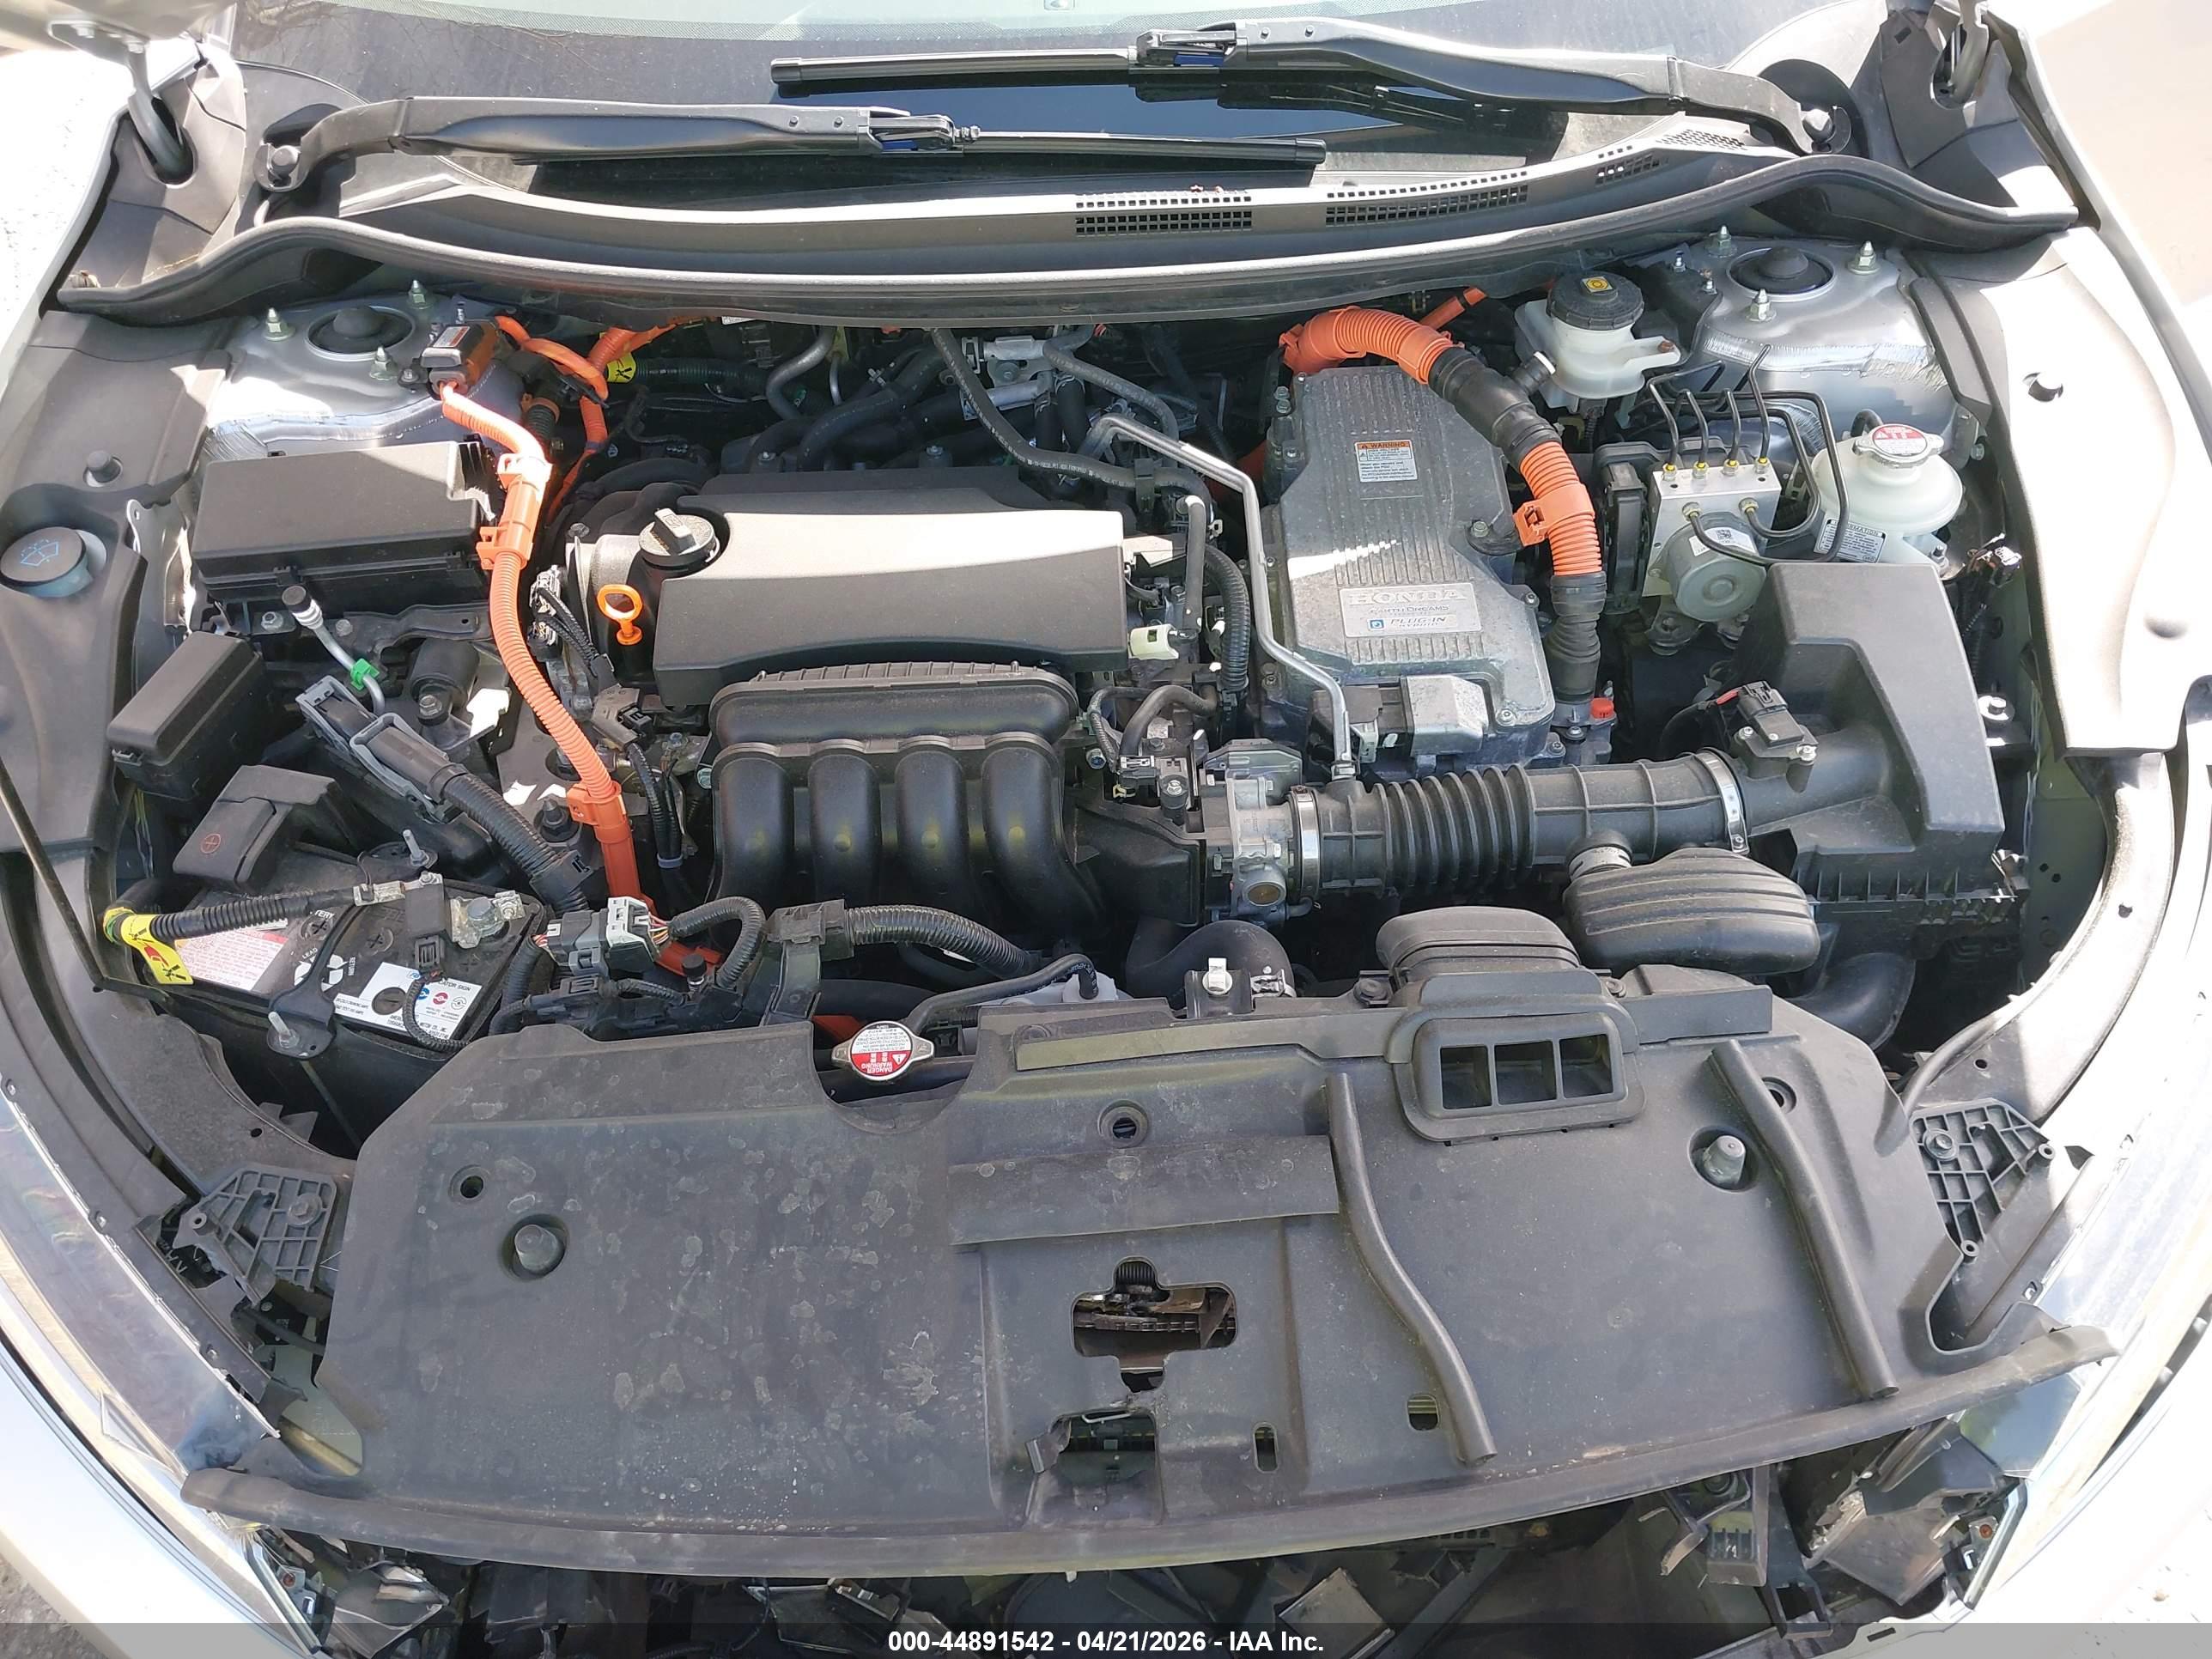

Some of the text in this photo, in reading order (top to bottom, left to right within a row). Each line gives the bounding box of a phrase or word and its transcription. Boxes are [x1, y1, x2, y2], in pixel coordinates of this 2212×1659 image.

[1348, 589, 1468, 605] HONDA
[1390, 616, 1446, 624] PLUG-IN
[301, 947, 319, 960] LEAD
